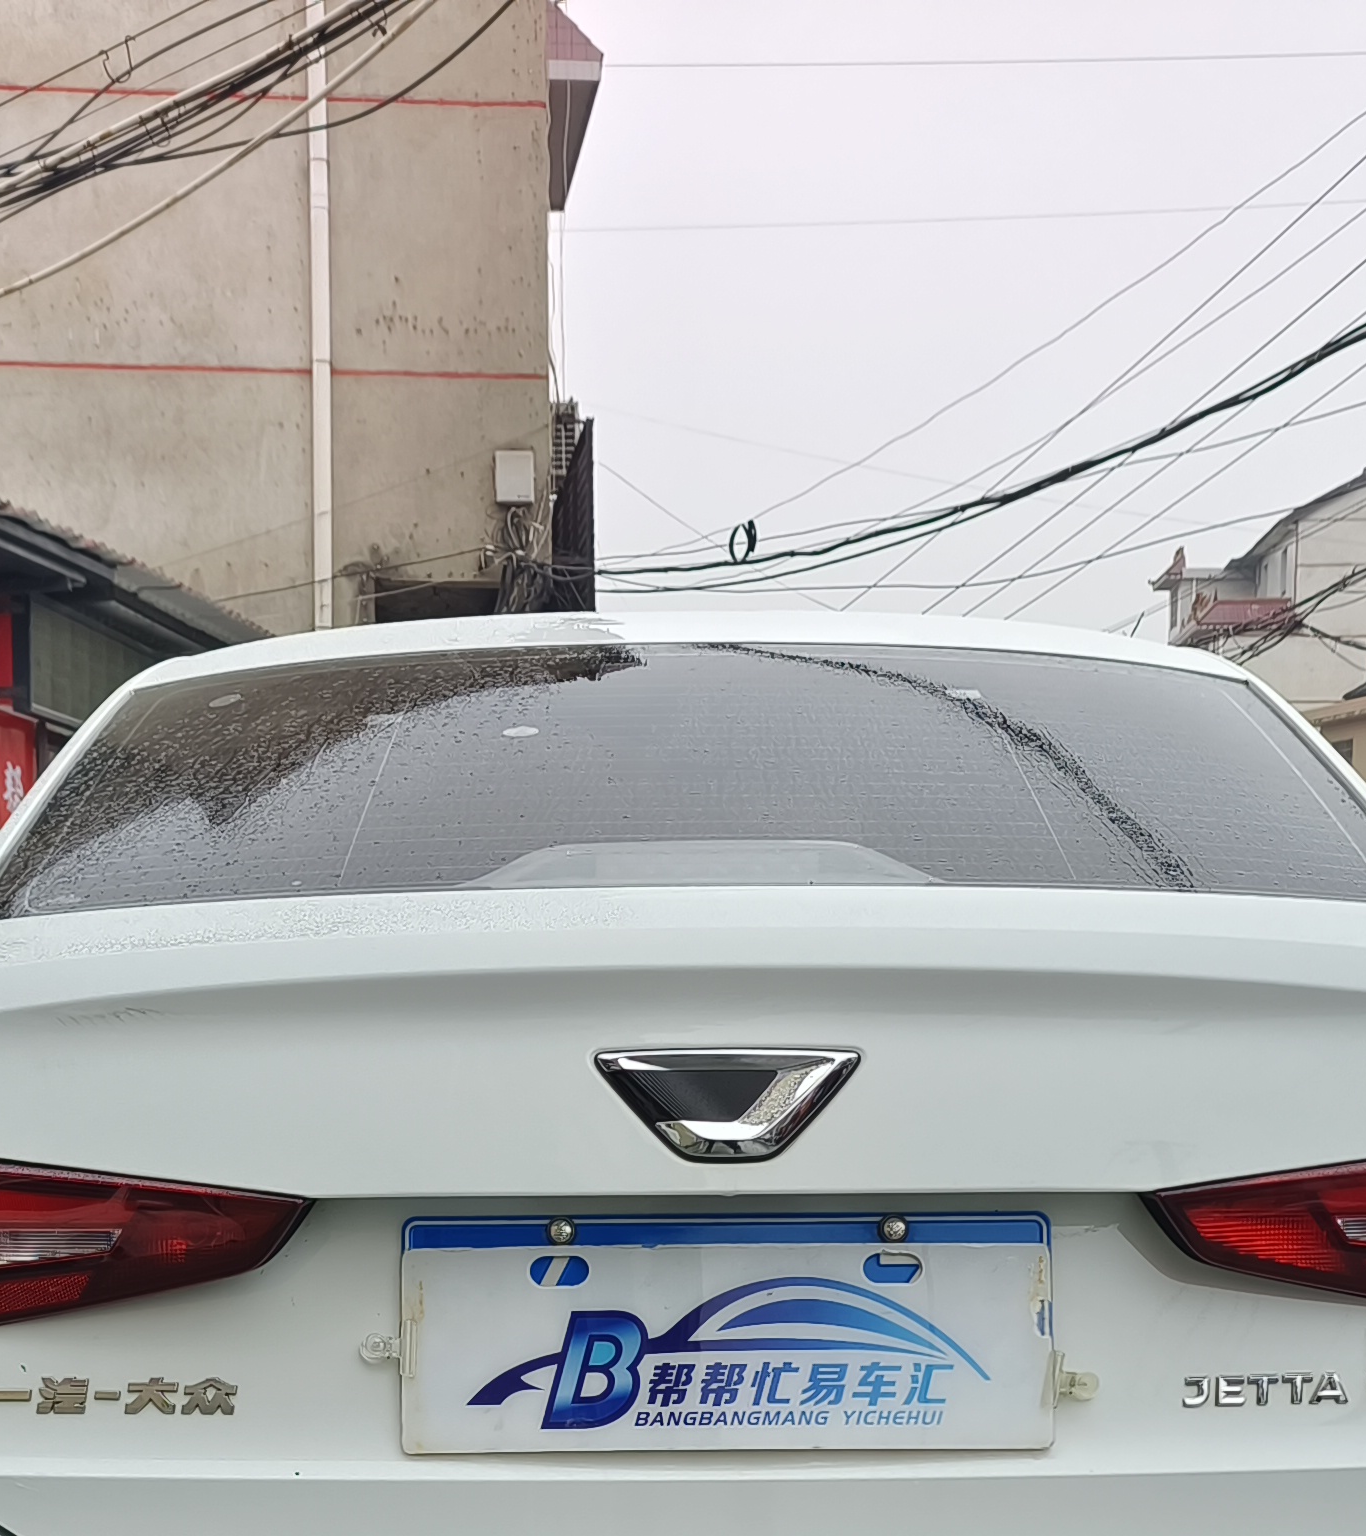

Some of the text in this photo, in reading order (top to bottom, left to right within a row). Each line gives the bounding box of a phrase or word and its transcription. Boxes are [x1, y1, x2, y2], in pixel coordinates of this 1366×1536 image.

[647, 1361, 956, 1407] 帮帮忙易车汇
[1182, 1373, 1348, 1408] JETTA
[635, 1409, 945, 1428] BANGBANGMANG YICHEHUI
